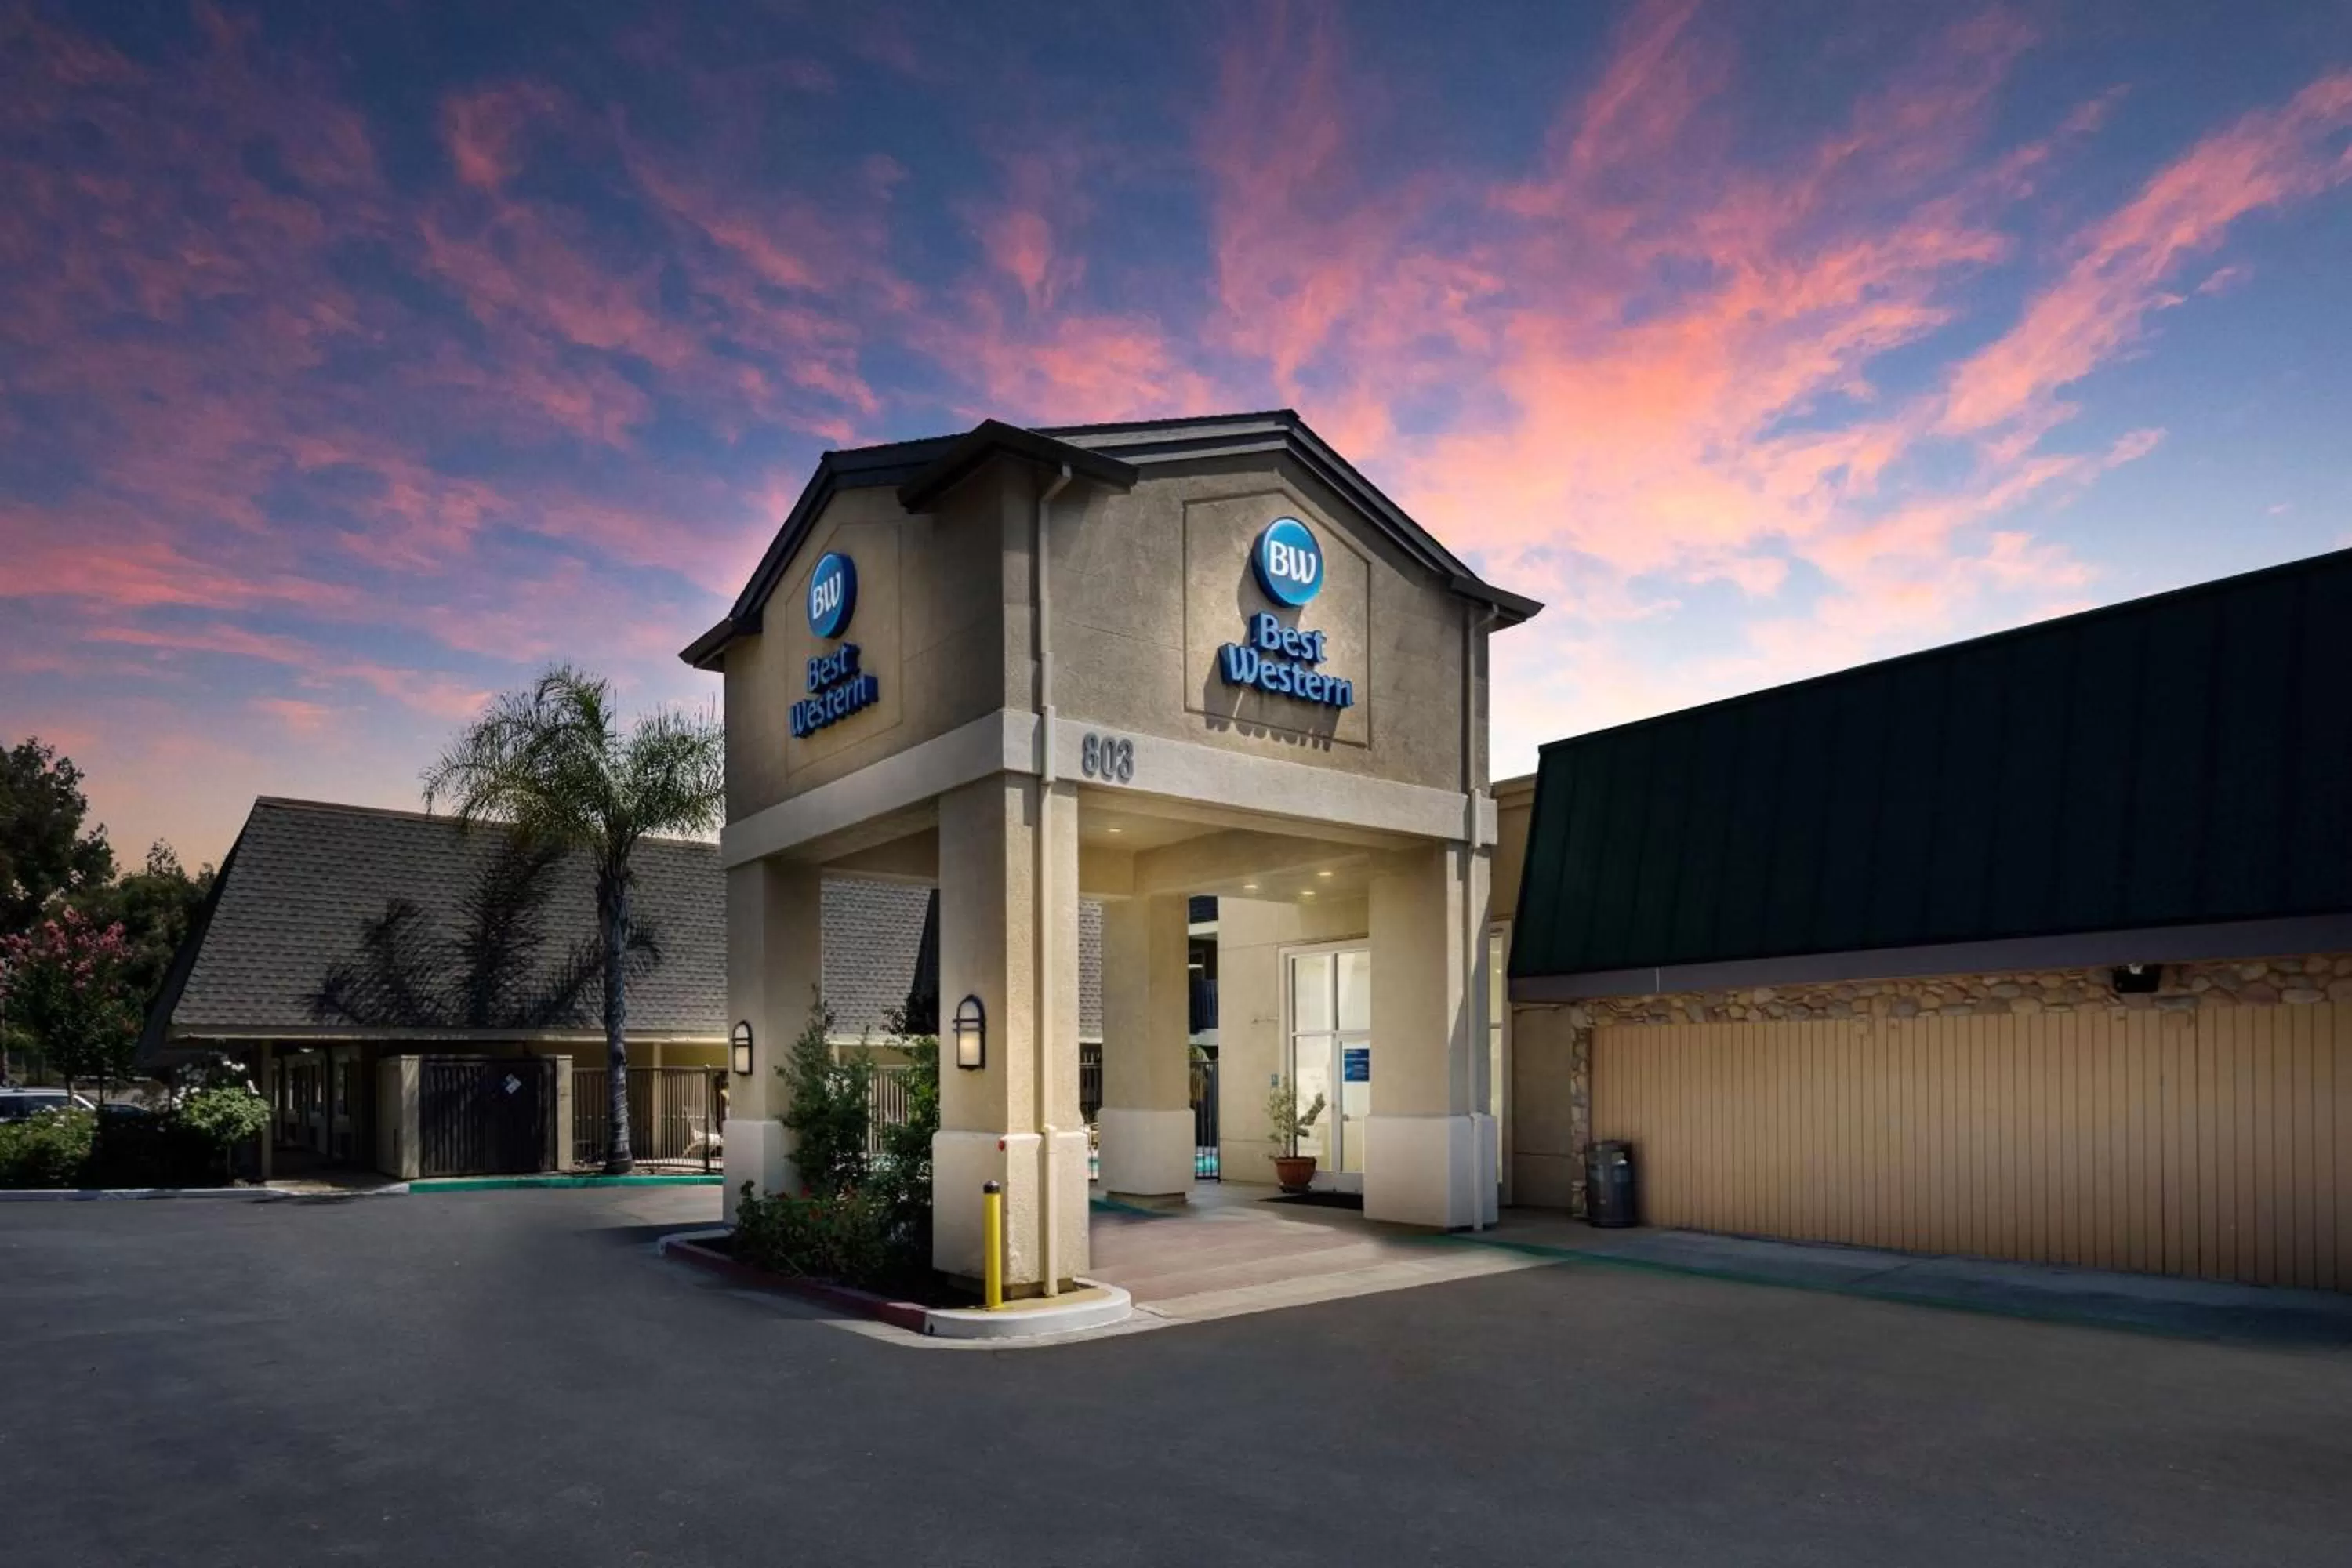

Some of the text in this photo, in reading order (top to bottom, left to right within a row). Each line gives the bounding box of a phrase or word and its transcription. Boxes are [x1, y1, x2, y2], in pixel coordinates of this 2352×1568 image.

[1269, 539, 1316, 585] BW
[811, 572, 842, 619] BW
[1256, 612, 1327, 660] Best
[808, 642, 851, 693] Best
[1225, 644, 1354, 707] Western
[789, 679, 867, 735] Western
[1081, 731, 1134, 783] 803
